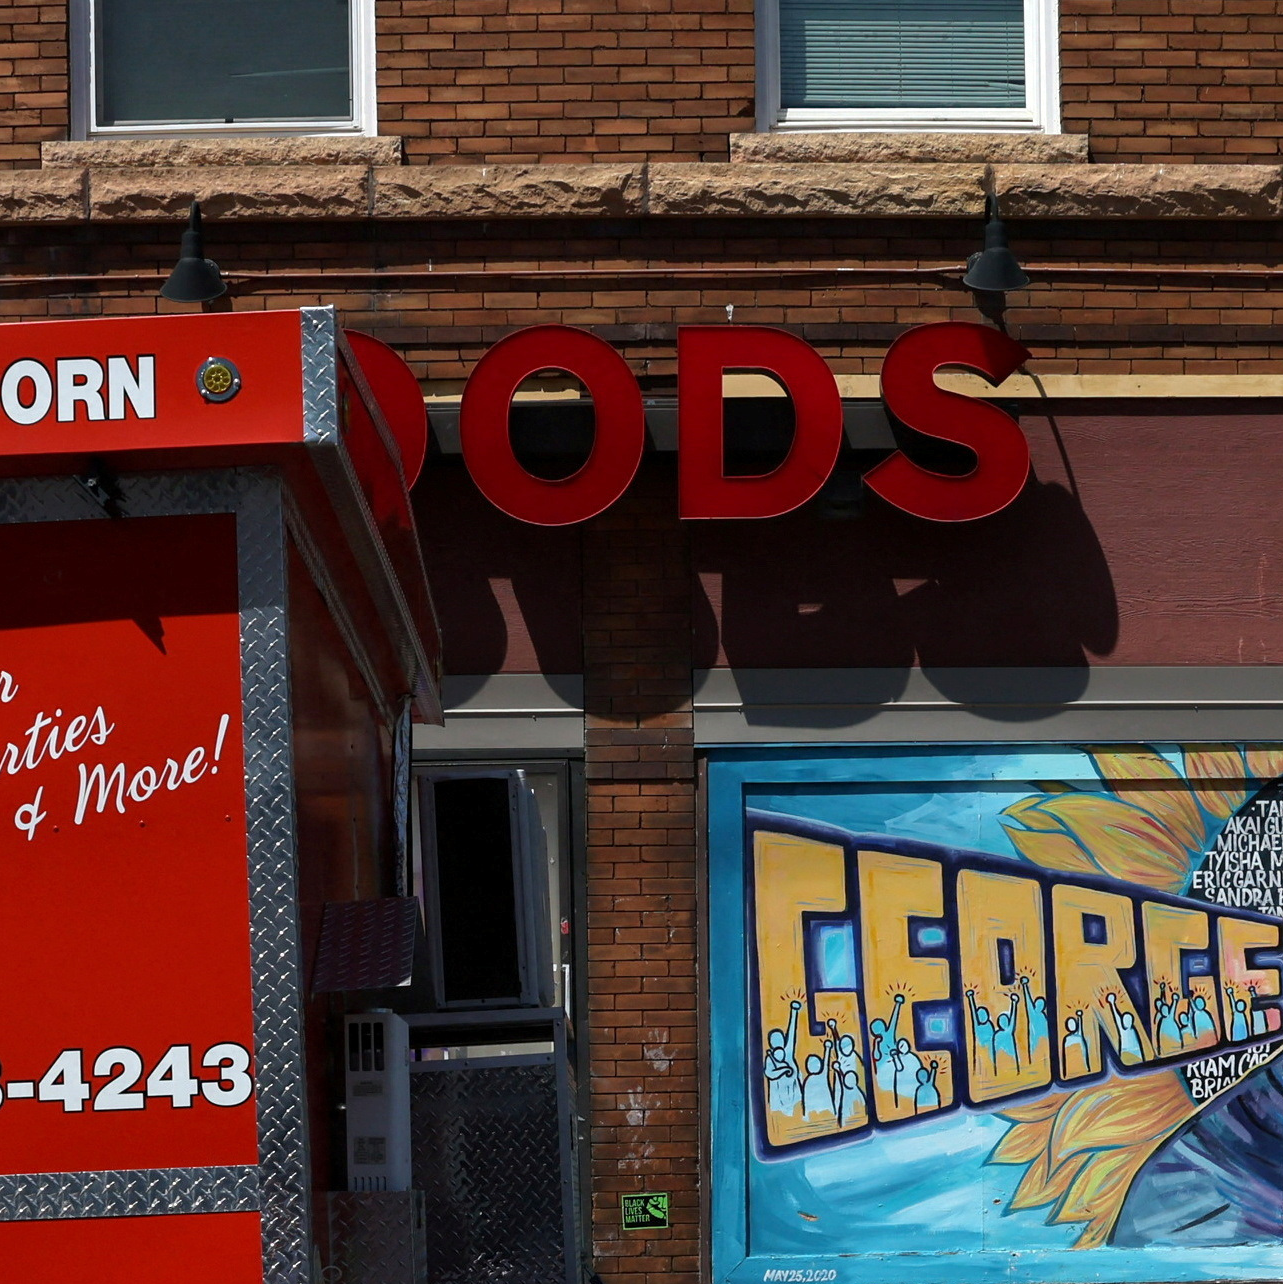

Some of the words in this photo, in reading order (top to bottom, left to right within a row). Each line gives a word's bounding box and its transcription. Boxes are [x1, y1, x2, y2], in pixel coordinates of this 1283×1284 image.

[14, 786, 47, 841] &
[74, 713, 230, 826] More!
[1224, 816, 1261, 835] AKAI
[1204, 852, 1264, 872] TYISHA
[1192, 870, 1233, 889] ERIC
[1205, 888, 1273, 906] SANDRA
[624, 1199, 645, 1208] BLACK
[625, 1207, 643, 1216] LIVES
[625, 1214, 651, 1224] MATTER
